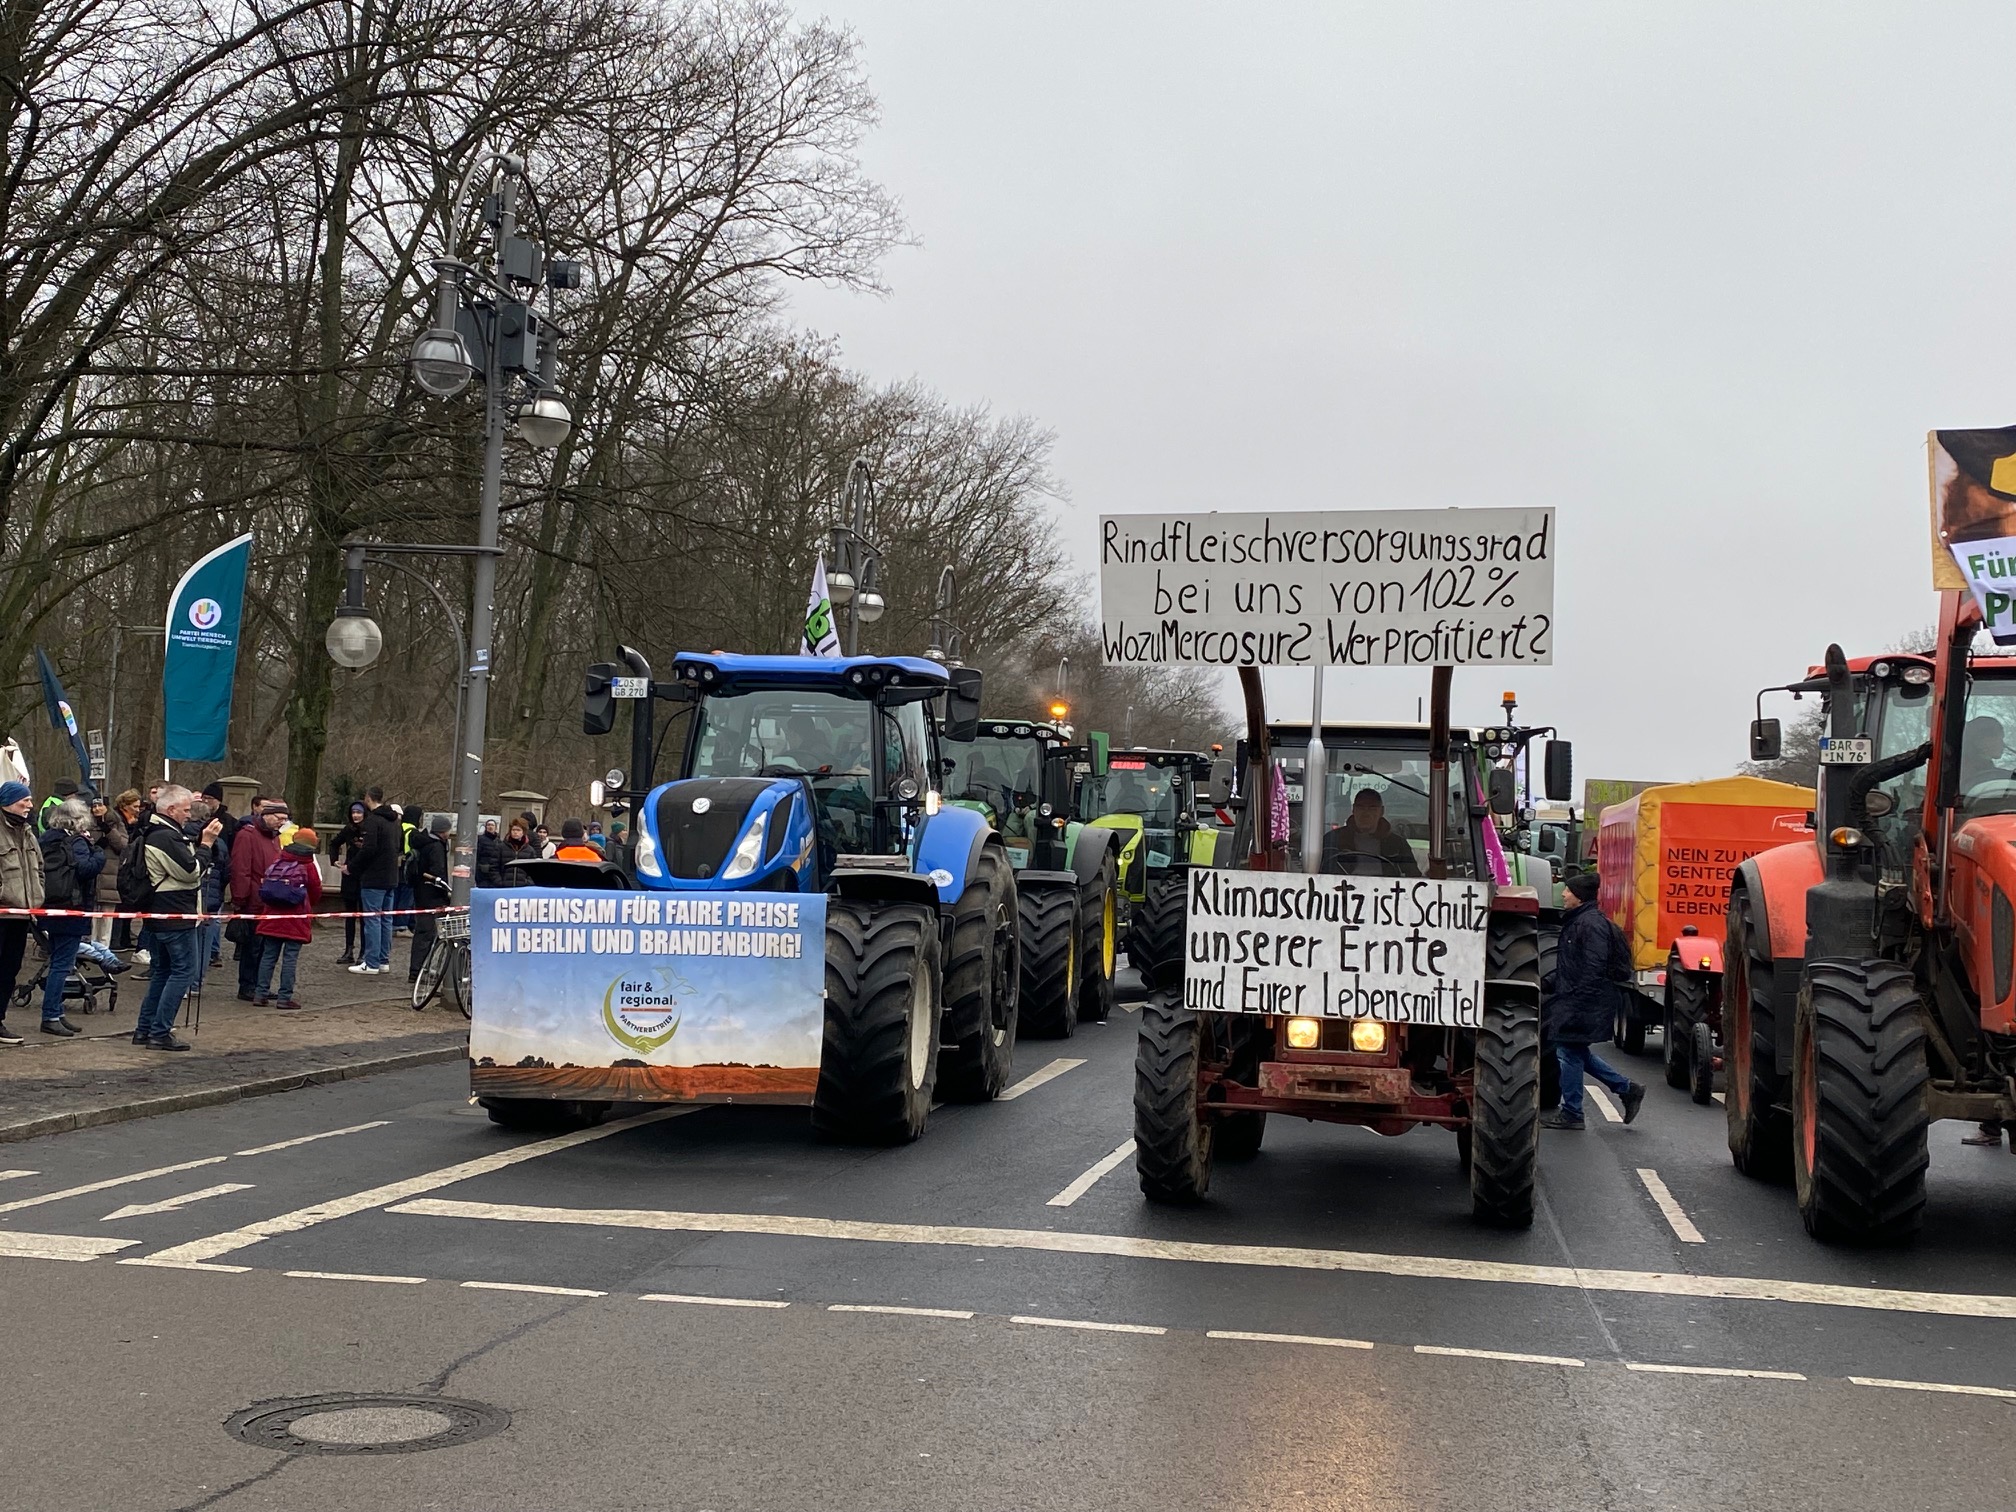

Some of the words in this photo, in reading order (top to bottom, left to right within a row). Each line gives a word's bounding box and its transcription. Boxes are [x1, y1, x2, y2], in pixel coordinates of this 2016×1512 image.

[1103, 513, 1548, 564] Rindfleischversorgungsgrad
[1154, 569, 1210, 615] bei
[1235, 582, 1302, 615] uns
[198, 637, 232, 645] TIERSCHUTZ
[629, 688, 644, 696] 270
[1829, 740, 1852, 751] BAR
[1829, 752, 1844, 762] IN
[1849, 752, 1864, 762] 76
[1668, 848, 1708, 861] NEIN
[1714, 849, 1737, 863] ZU
[1666, 883, 1689, 896] JA
[1693, 884, 1716, 898] ZU
[1191, 870, 1365, 925] Klimaschutz
[1373, 880, 1406, 926] ist
[1410, 881, 1488, 933] Schutz
[494, 897, 616, 925] GEMEINSAM
[621, 895, 660, 925] FÜR
[665, 900, 722, 927] FAIRE
[728, 901, 799, 929] PREISE
[491, 928, 511, 953] IN
[516, 928, 587, 955] BERLIN
[591, 929, 634, 955] UND
[639, 930, 802, 959] BRANDENBURG!
[1190, 929, 1322, 969] unserer
[1340, 926, 1447, 977] Ernte
[620, 981, 642, 993] fair
[644, 981, 653, 993] &
[620, 994, 673, 1007] regional
[1186, 966, 1225, 1010] und
[1241, 967, 1306, 1016] Eurer
[1323, 971, 1481, 1027] Lebensmittel
[619, 1014, 673, 1033] PARTNERBETRIEB
